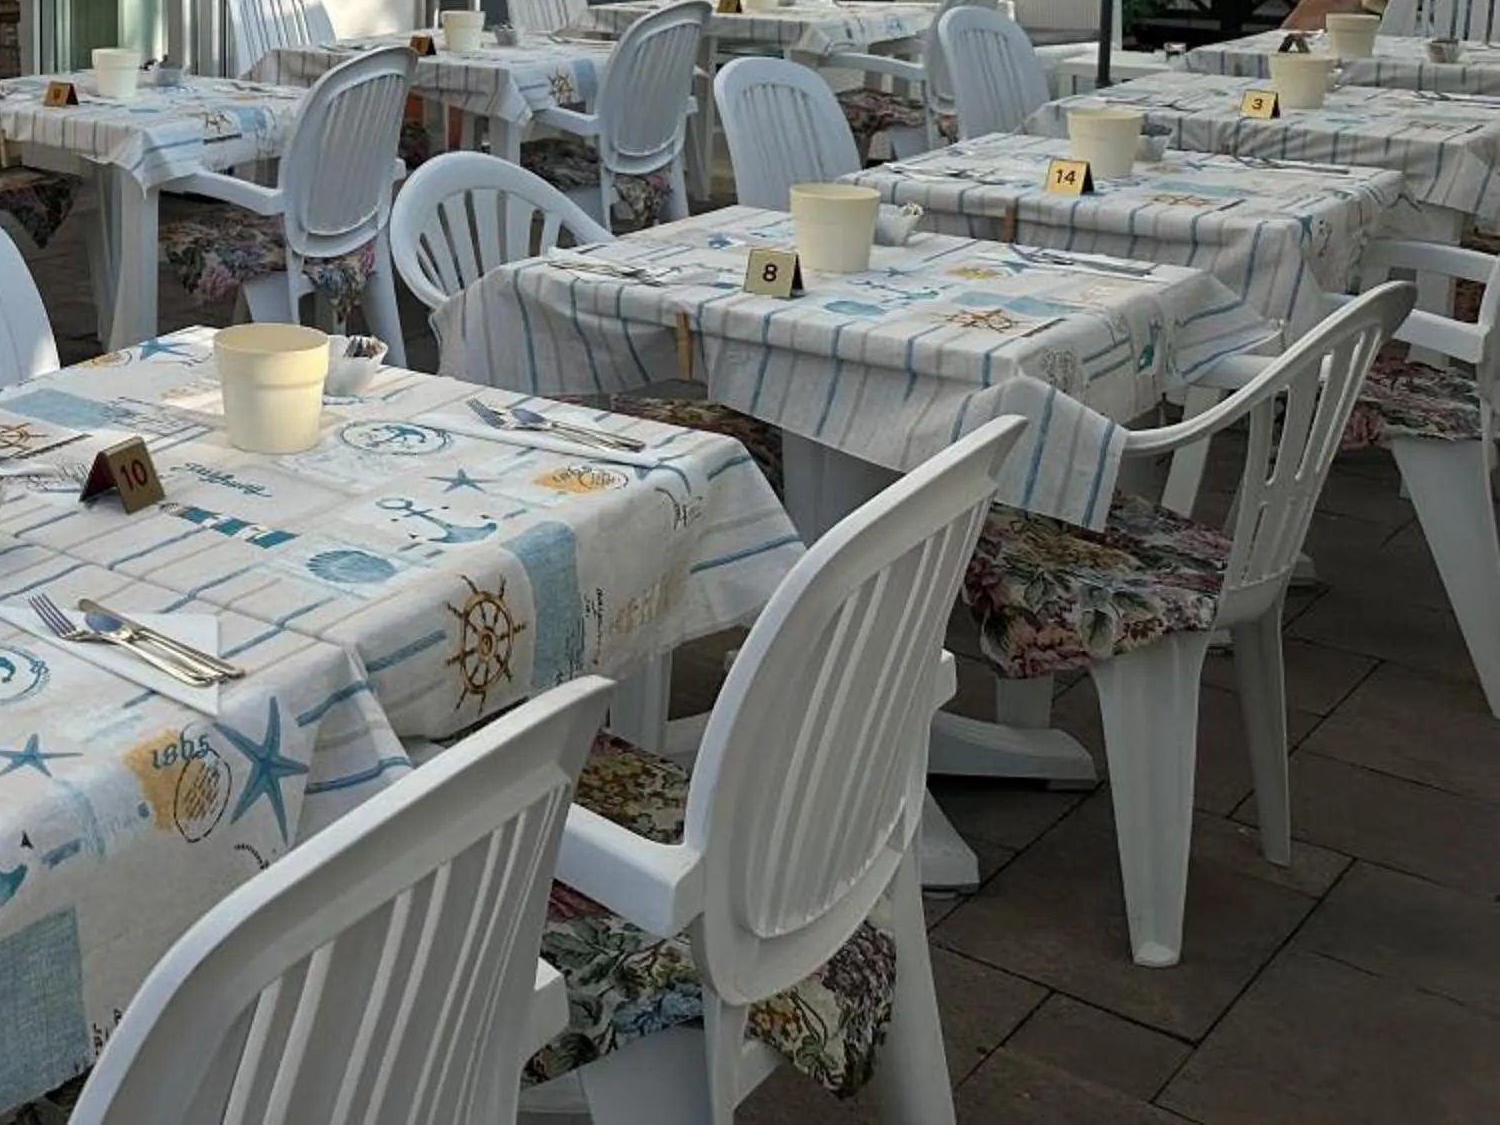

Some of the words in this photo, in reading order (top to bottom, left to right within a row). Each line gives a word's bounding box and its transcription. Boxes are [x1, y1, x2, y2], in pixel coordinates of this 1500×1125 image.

[1251, 98, 1265, 111] 3
[1056, 168, 1076, 186] 14
[762, 262, 778, 283] 8
[120, 459, 149, 492] 10
